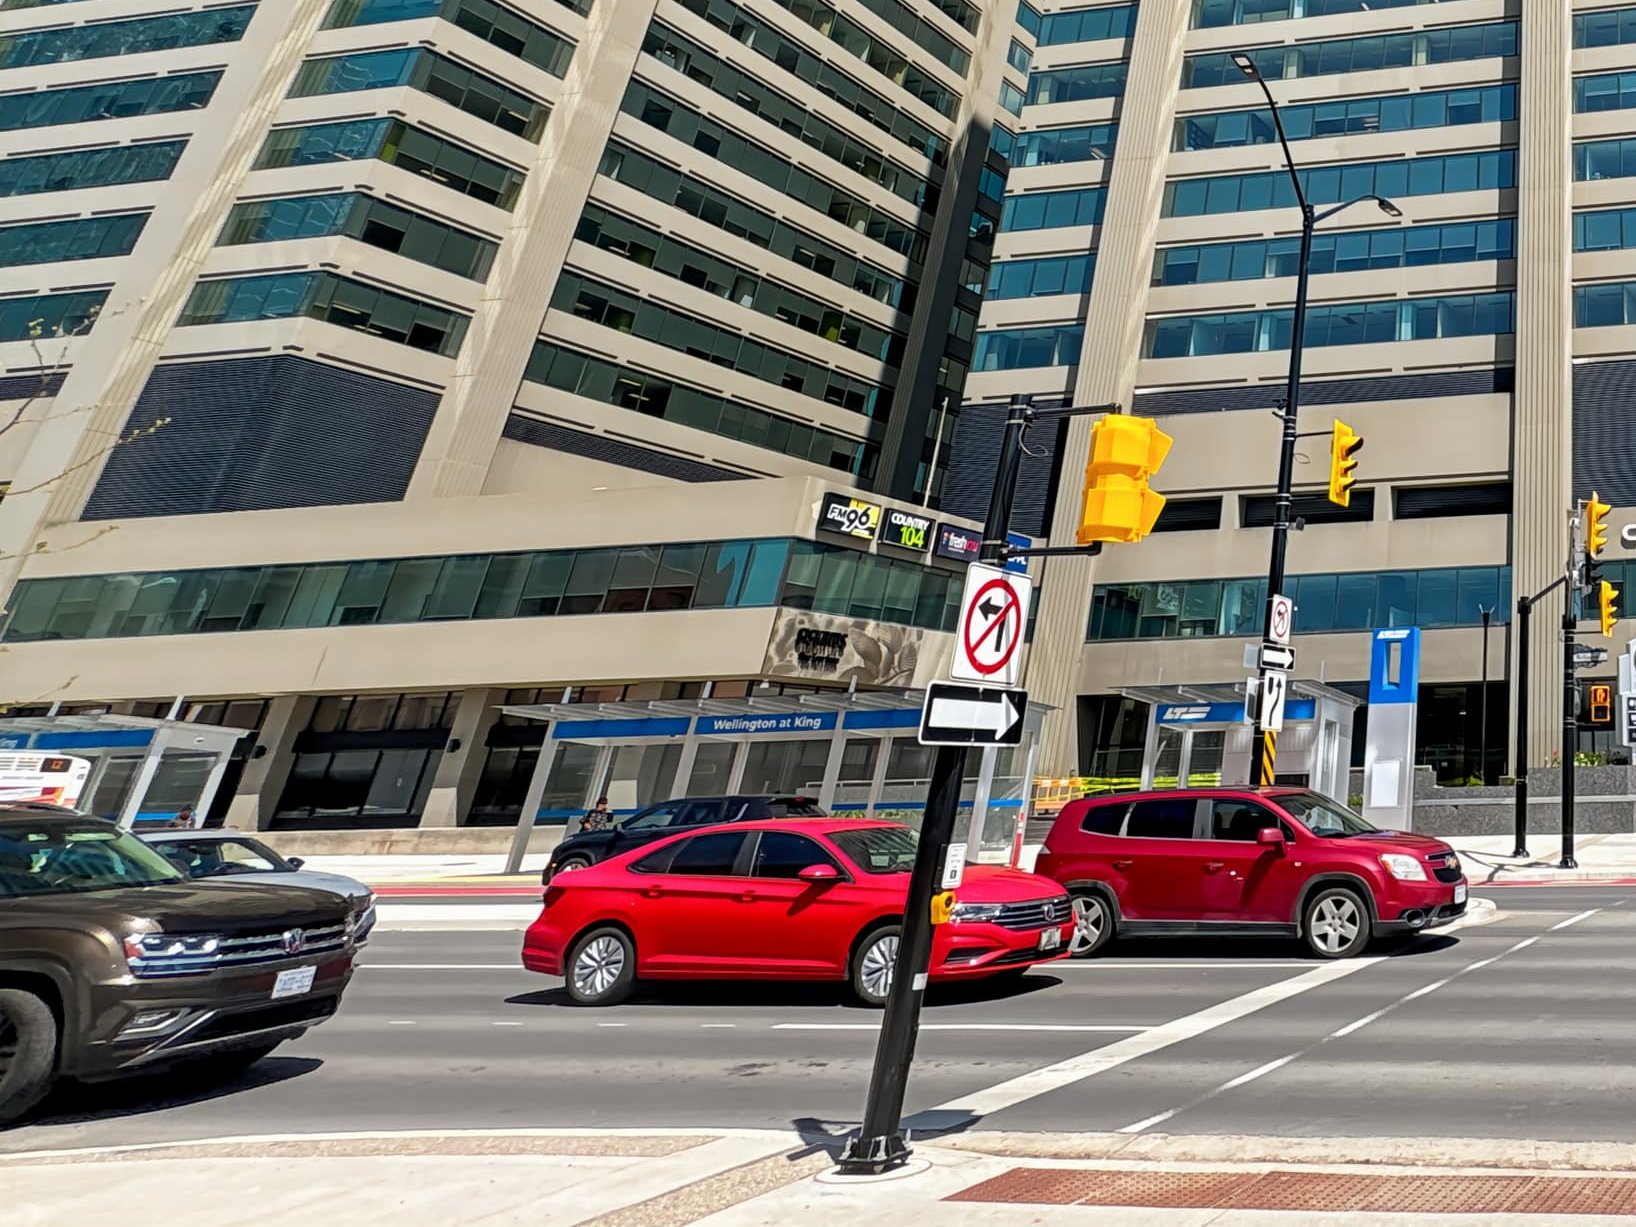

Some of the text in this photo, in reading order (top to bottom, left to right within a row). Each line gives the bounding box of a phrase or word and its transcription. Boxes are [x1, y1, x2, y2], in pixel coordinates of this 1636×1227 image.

[891, 513, 929, 530] COUNTRY
[900, 527, 924, 548] 104
[713, 716, 822, 731] Wellington at King
